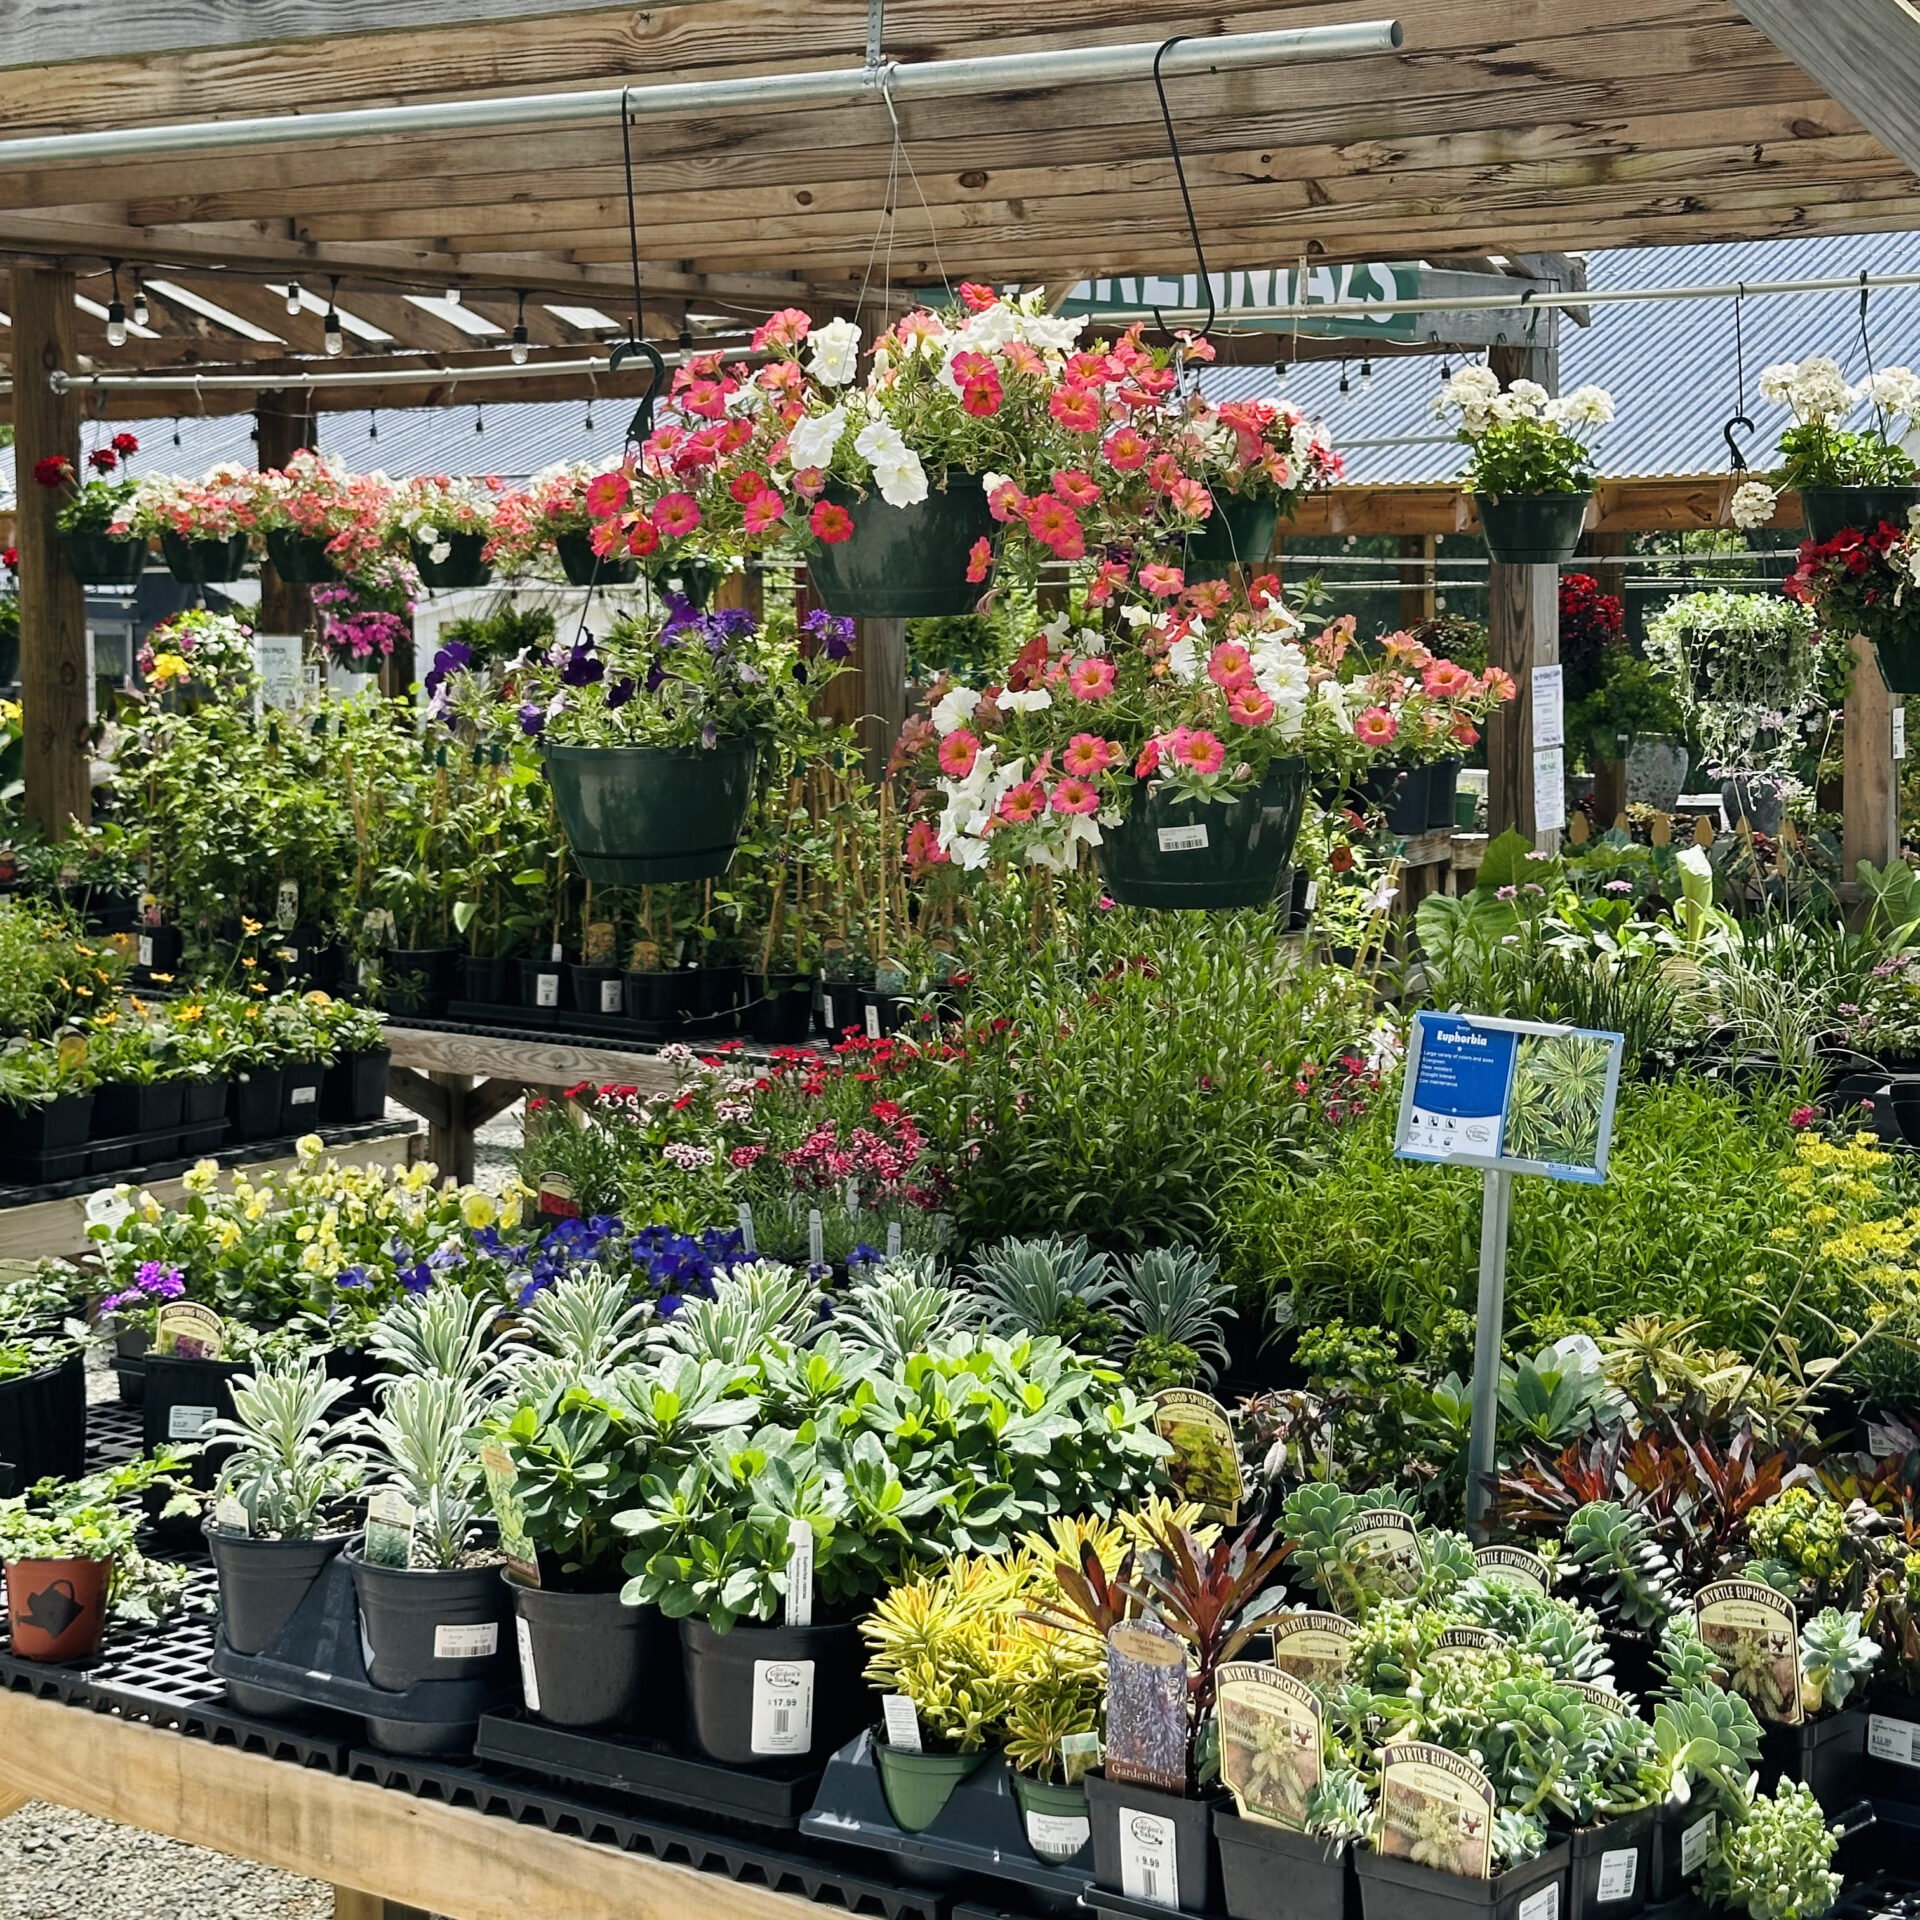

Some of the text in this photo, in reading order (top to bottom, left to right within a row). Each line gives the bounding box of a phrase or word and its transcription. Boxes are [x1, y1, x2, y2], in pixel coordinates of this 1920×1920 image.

[1437, 1030, 1488, 1046] Euphorbia
[166, 1306, 195, 1318] CREEPING
[1162, 1392, 1216, 1413] WOOD SPURGE
[1500, 1551, 1544, 1580] EUPHORBIA
[1700, 1586, 1787, 1614] MYRTLE EUPHORBIA
[1278, 1616, 1352, 1638] MYRTLE EUPHORB
[1222, 1667, 1257, 1682] MYRTLE
[1258, 1669, 1314, 1708] EUPHORBIA
[1112, 1762, 1172, 1788] GardenRich
[1391, 1746, 1429, 1763] MYRTLE
[1431, 1750, 1487, 1794] EUPHORBIA
